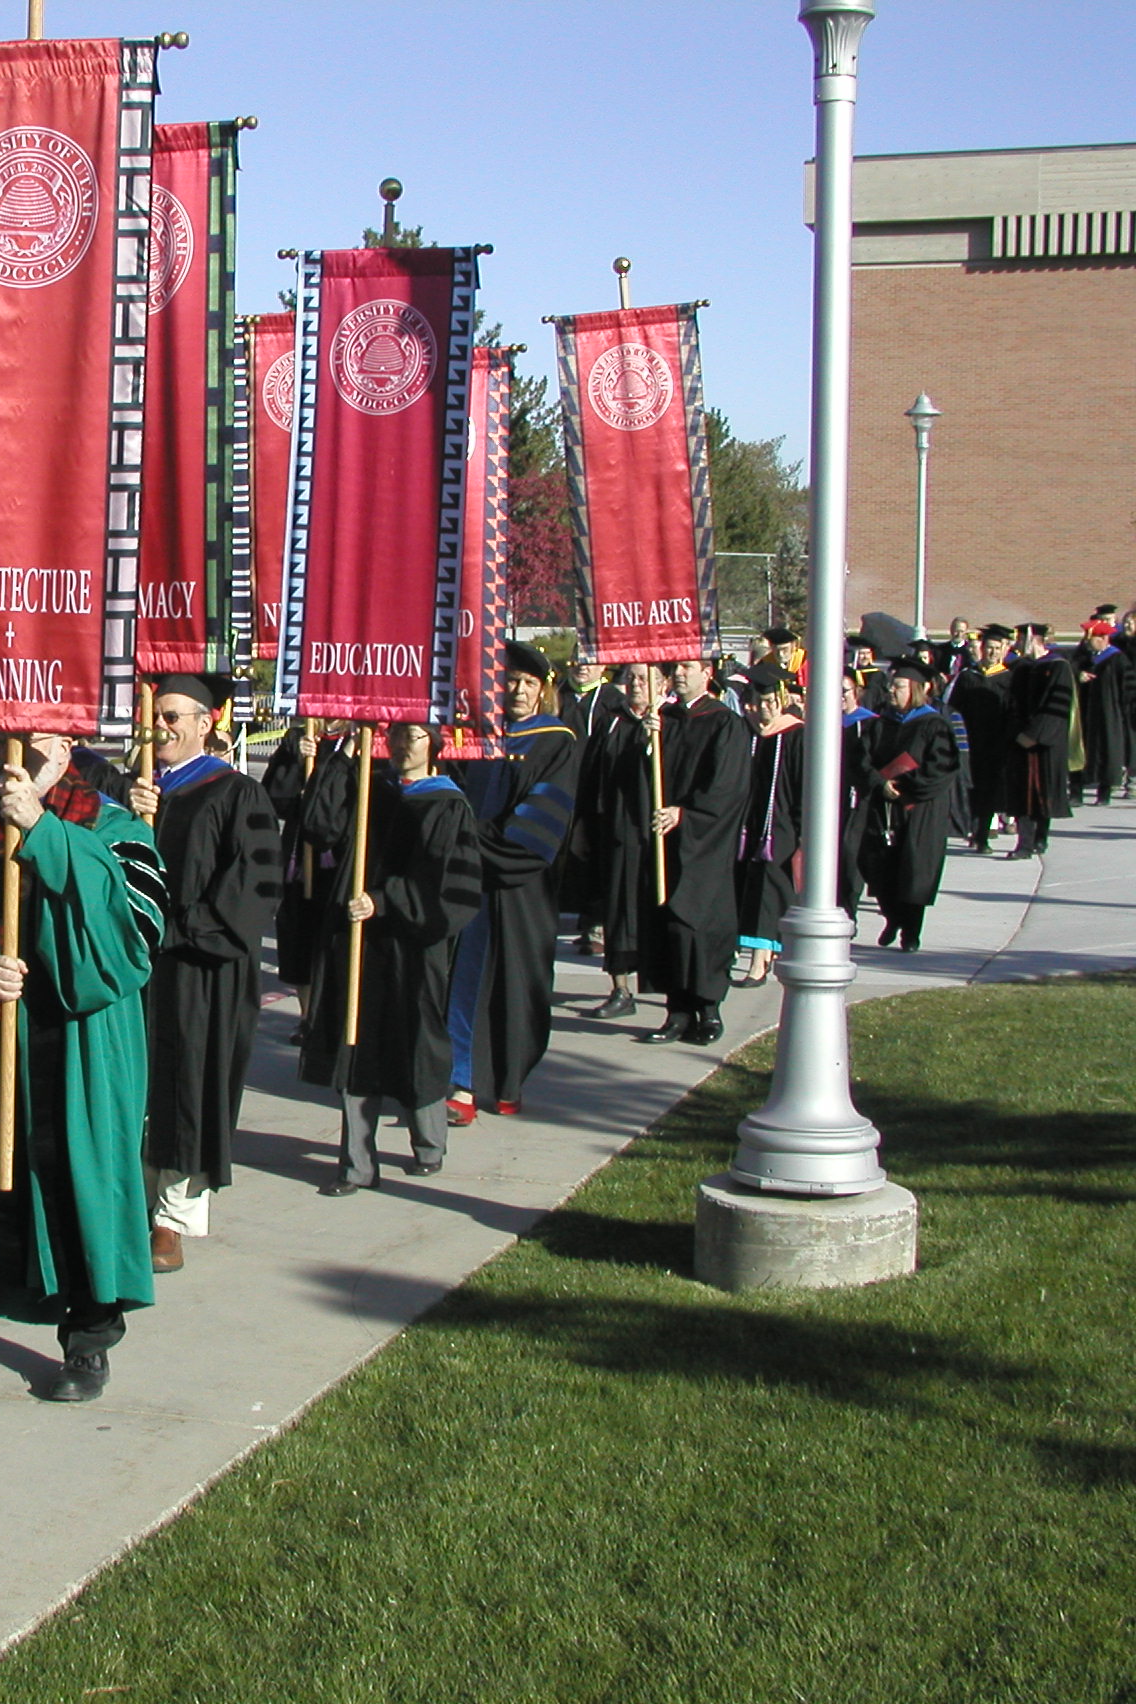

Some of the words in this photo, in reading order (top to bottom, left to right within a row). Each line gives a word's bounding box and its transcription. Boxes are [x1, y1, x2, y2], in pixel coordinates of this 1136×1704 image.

[48, 139, 75, 159] OF
[71, 158, 93, 217] UTAH
[168, 206, 187, 255] UTAH
[335, 304, 395, 365] UNIVERSITY
[350, 389, 414, 410] MDCCCL
[602, 601, 645, 628] FINE
[647, 597, 692, 626] ARTS
[309, 642, 424, 678] EDUCATION
